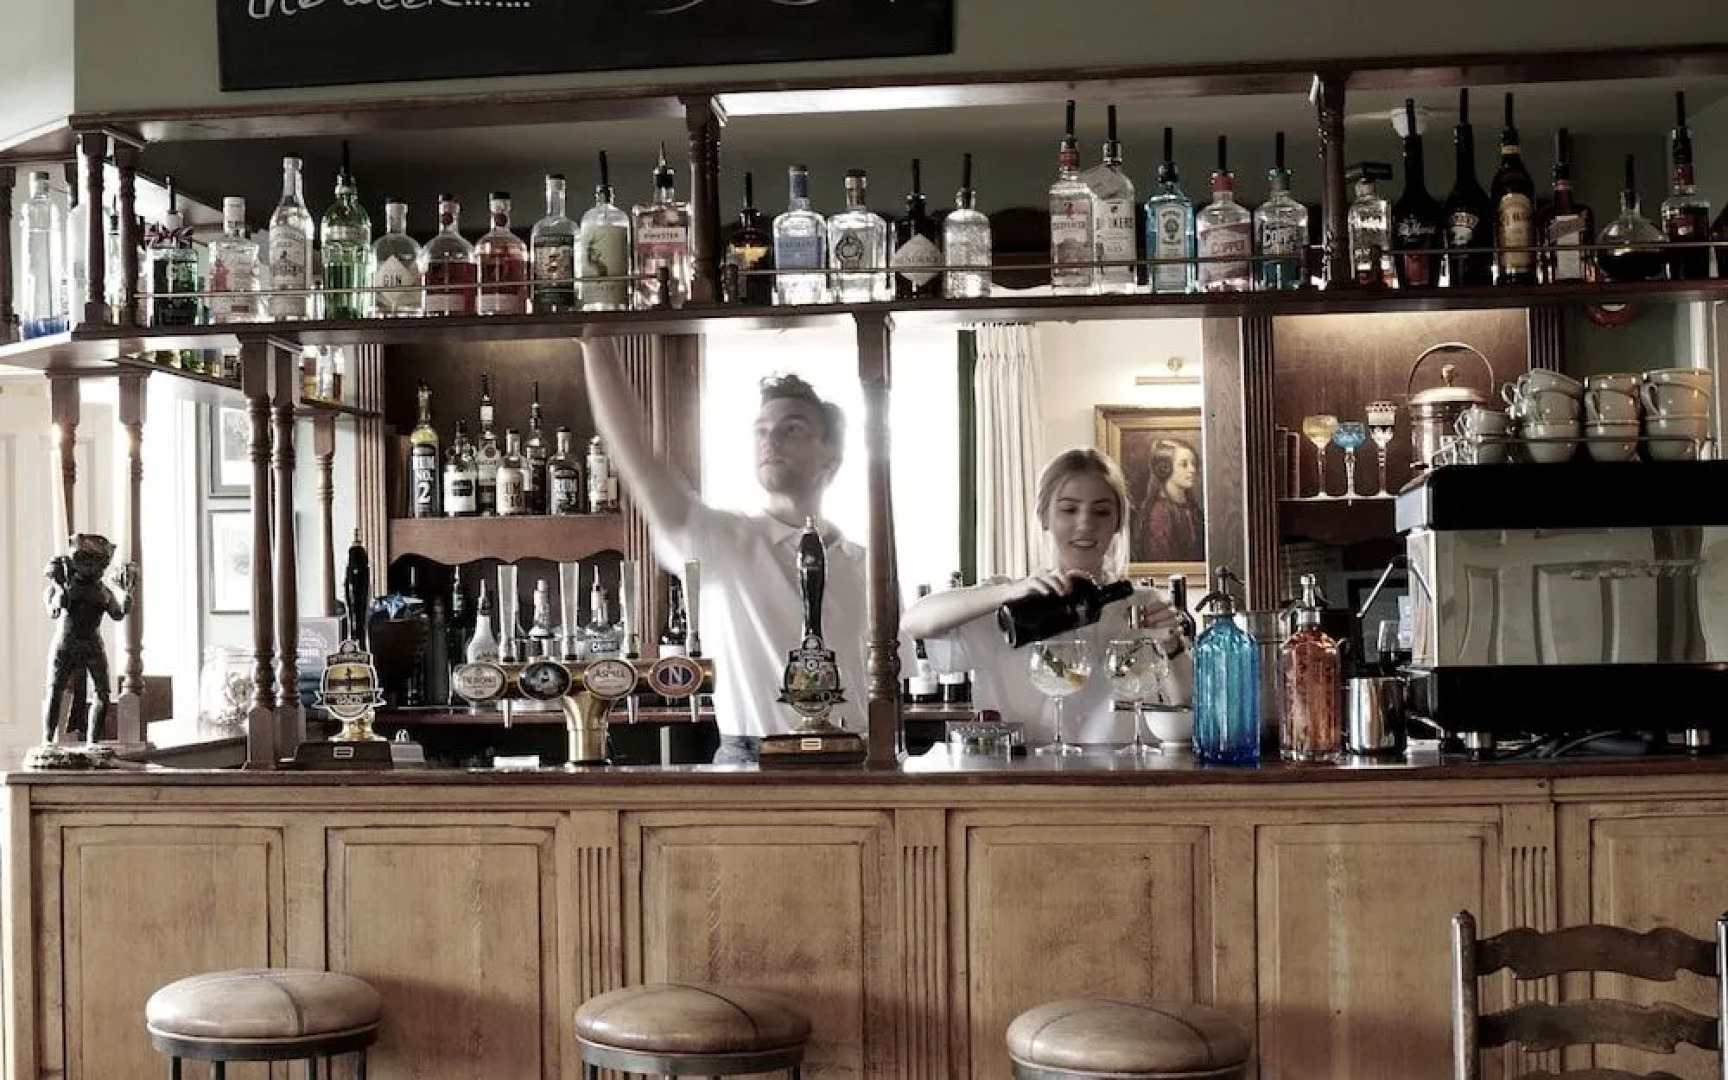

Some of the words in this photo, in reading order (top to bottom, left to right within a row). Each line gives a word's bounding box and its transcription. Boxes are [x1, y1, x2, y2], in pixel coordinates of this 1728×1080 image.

[384, 273, 402, 287] GIN
[418, 482, 431, 504] 2
[666, 664, 685, 685] N
